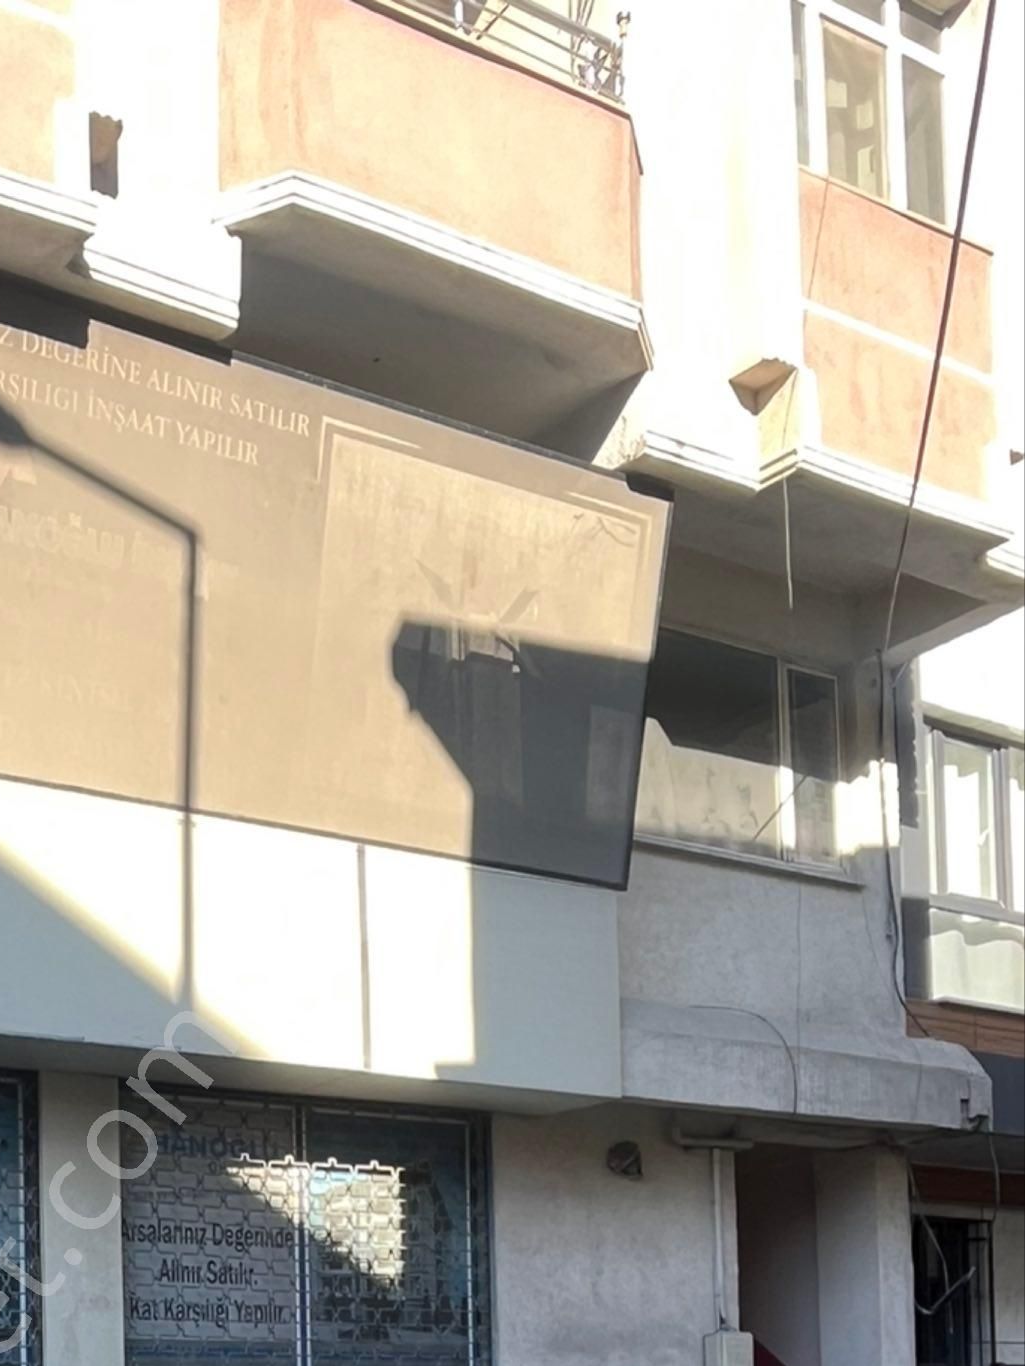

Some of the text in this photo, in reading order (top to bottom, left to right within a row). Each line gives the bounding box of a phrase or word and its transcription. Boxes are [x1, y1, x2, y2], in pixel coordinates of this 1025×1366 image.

[88, 387, 172, 434] İNŞAAT
[176, 420, 259, 466] YAPILIR
[146, 368, 223, 410] ALINIR
[229, 393, 310, 437] SATILIR
